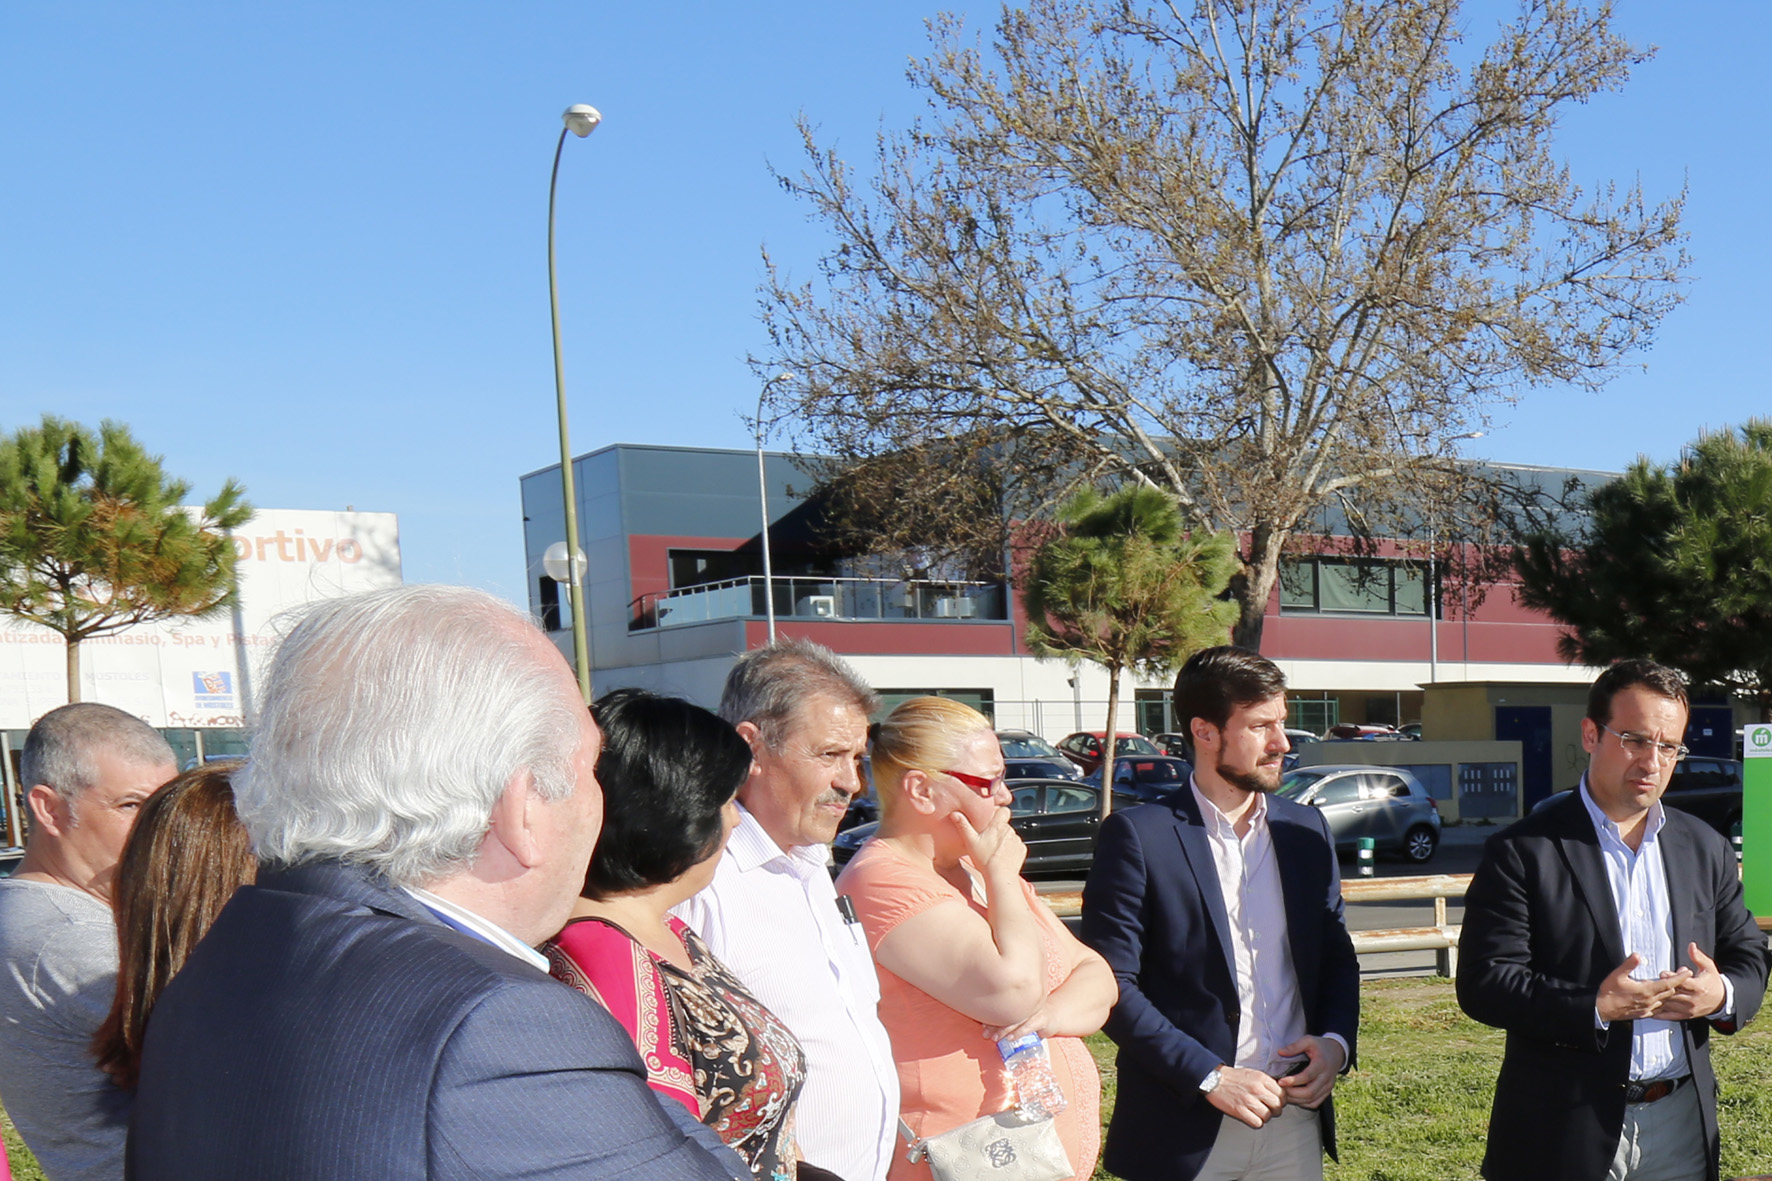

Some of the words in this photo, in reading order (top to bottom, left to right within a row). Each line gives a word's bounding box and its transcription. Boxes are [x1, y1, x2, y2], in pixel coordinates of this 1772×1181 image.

[232, 528, 364, 564] ortivo
[0, 630, 68, 646] tizada,
[171, 632, 205, 648] Spa
[211, 635, 220, 648] y
[226, 632, 278, 646] Pstas
